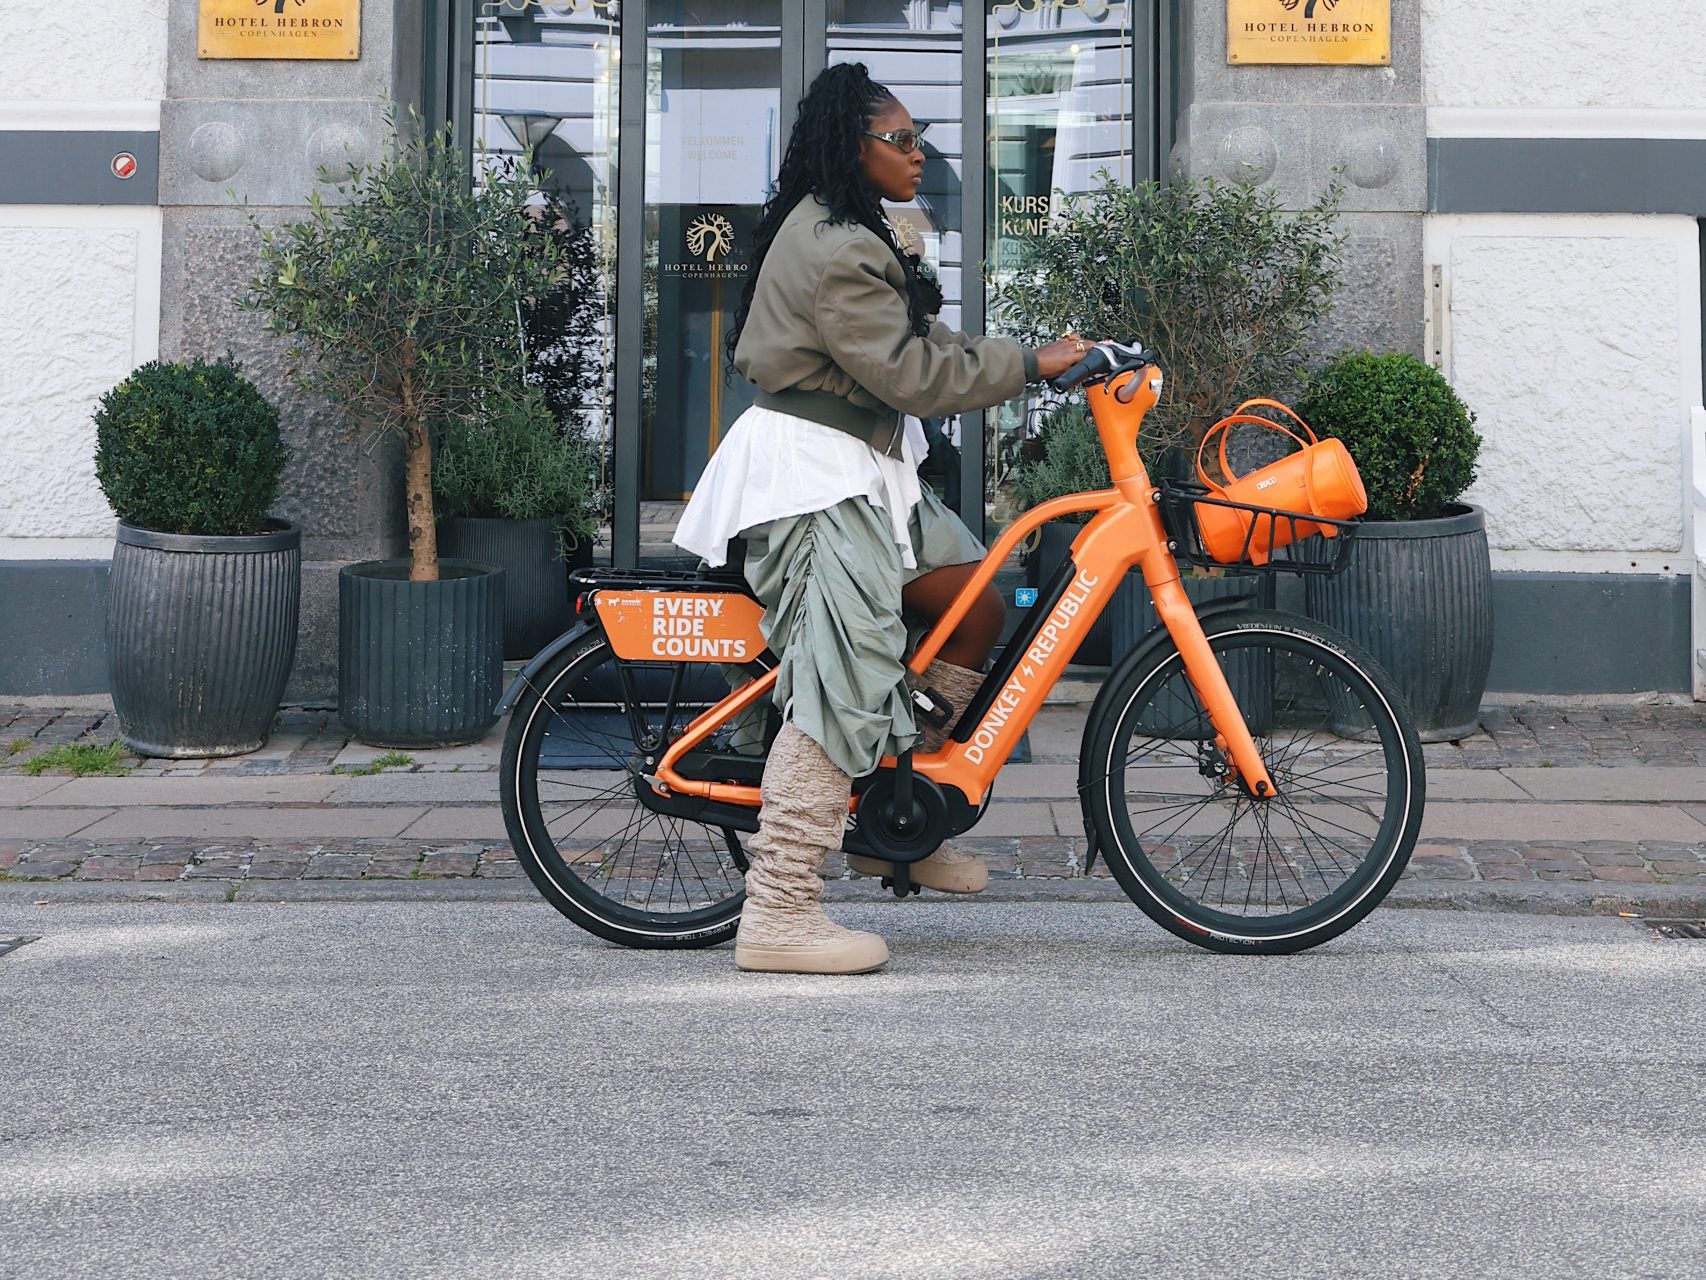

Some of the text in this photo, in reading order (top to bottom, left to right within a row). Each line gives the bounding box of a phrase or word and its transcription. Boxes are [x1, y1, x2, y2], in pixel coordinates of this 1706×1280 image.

[215, 17, 344, 28] HOTEL HEBRON
[1244, 22, 1375, 33] HOTEL HEBRON
[240, 30, 318, 38] COPENHAGEN
[1270, 34, 1349, 42] COPENHAGEN
[681, 136, 744, 146] VELKOMMEN
[687, 150, 737, 160] WELCOME
[664, 263, 748, 271] HOTEL HEBRO
[652, 597, 724, 617] EVERY
[652, 617, 705, 637] RIDE
[651, 637, 747, 658] COUNTS
[1292, 627, 1326, 645] PERFECT
[1326, 640, 1347, 656] TOUR
[963, 568, 1099, 766] DONKEY REPUBLIC
[698, 923, 731, 939] PERFECT
[1209, 932, 1256, 946] PROTECTION
